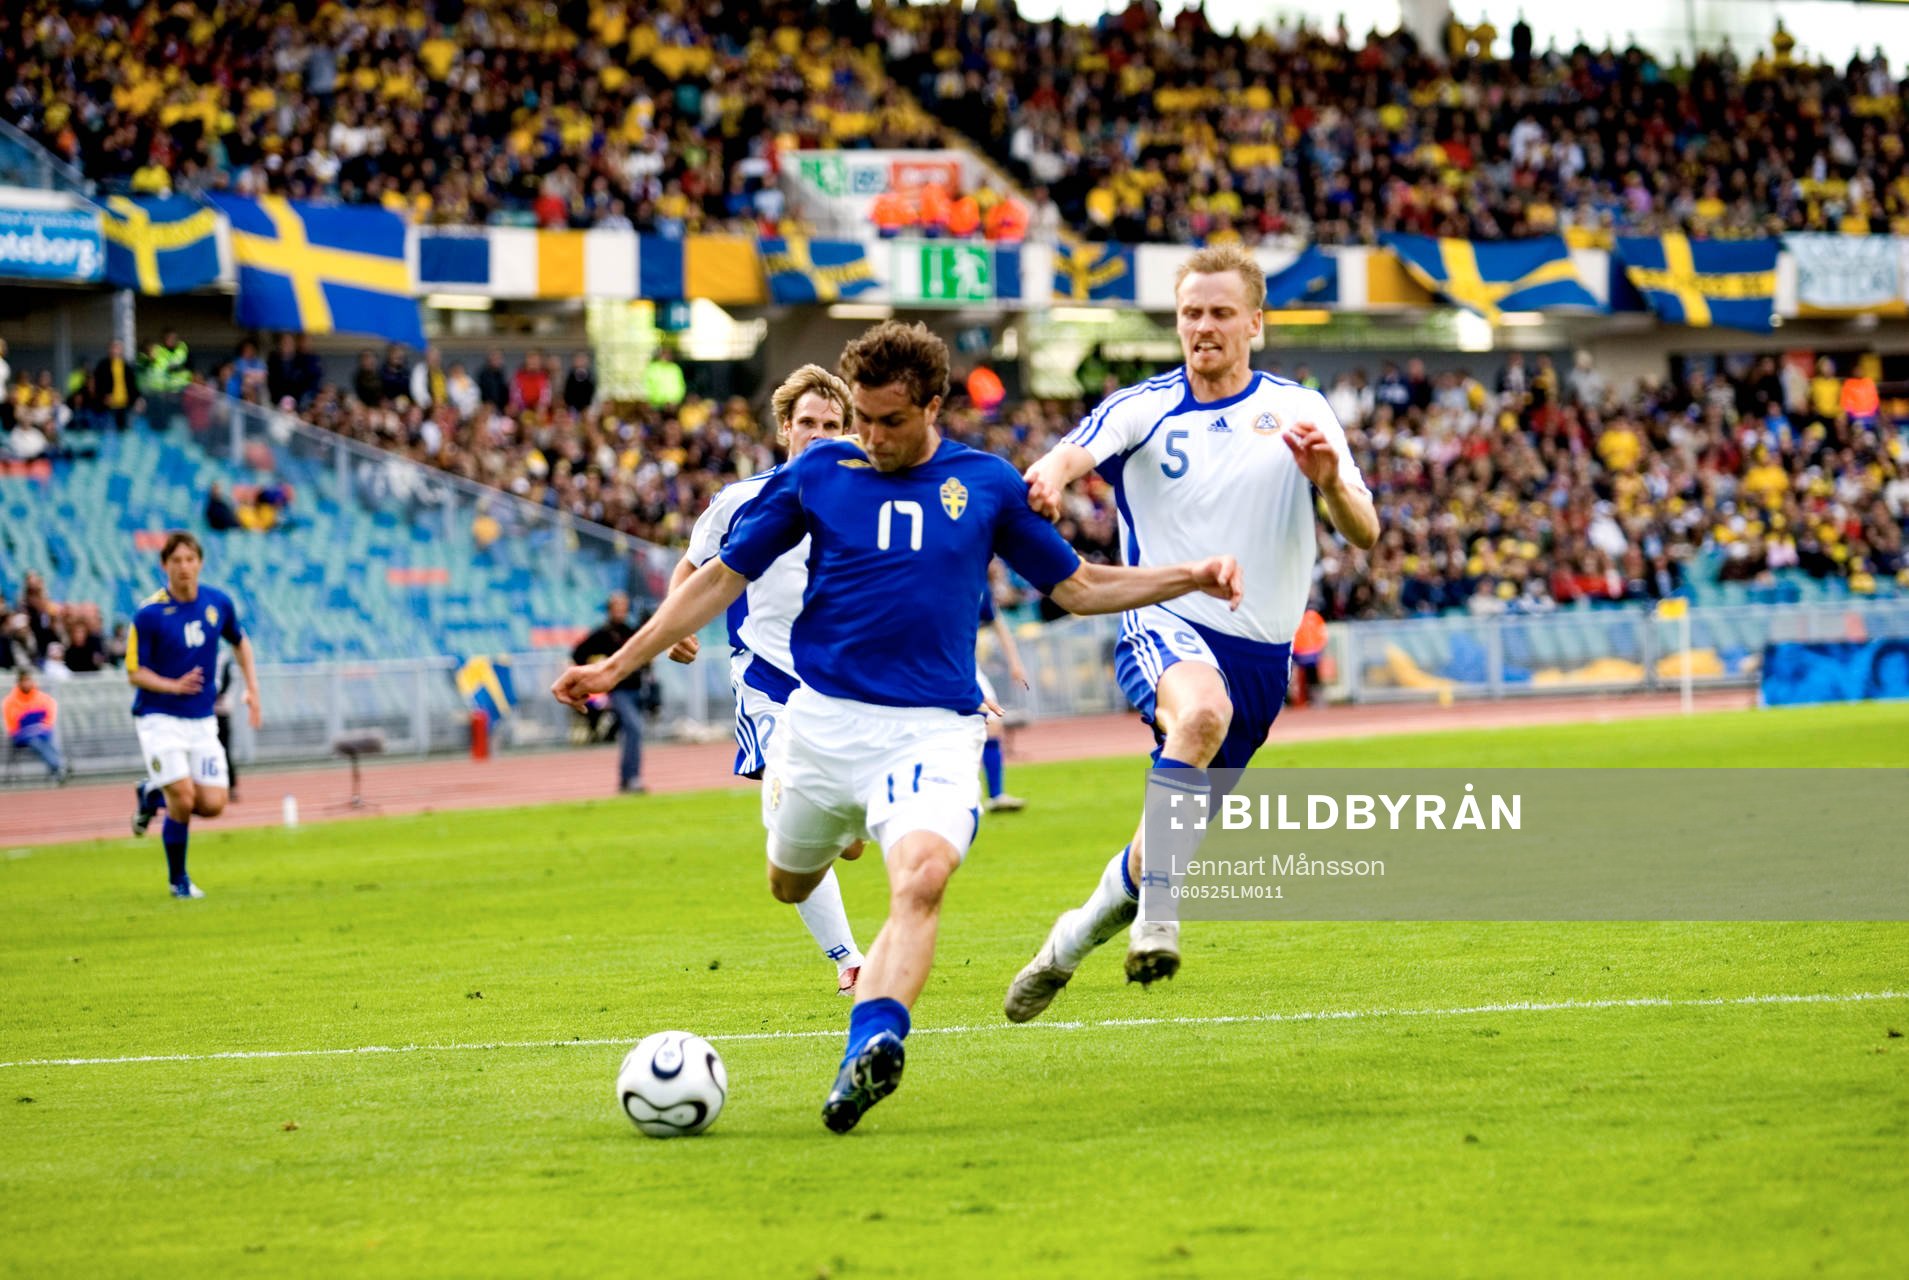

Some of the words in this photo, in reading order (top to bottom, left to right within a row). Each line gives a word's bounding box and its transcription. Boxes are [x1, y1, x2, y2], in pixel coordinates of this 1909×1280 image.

[1160, 430, 1189, 479] 5
[877, 500, 924, 551] 17
[184, 620, 206, 648] 16
[202, 756, 219, 777] 16
